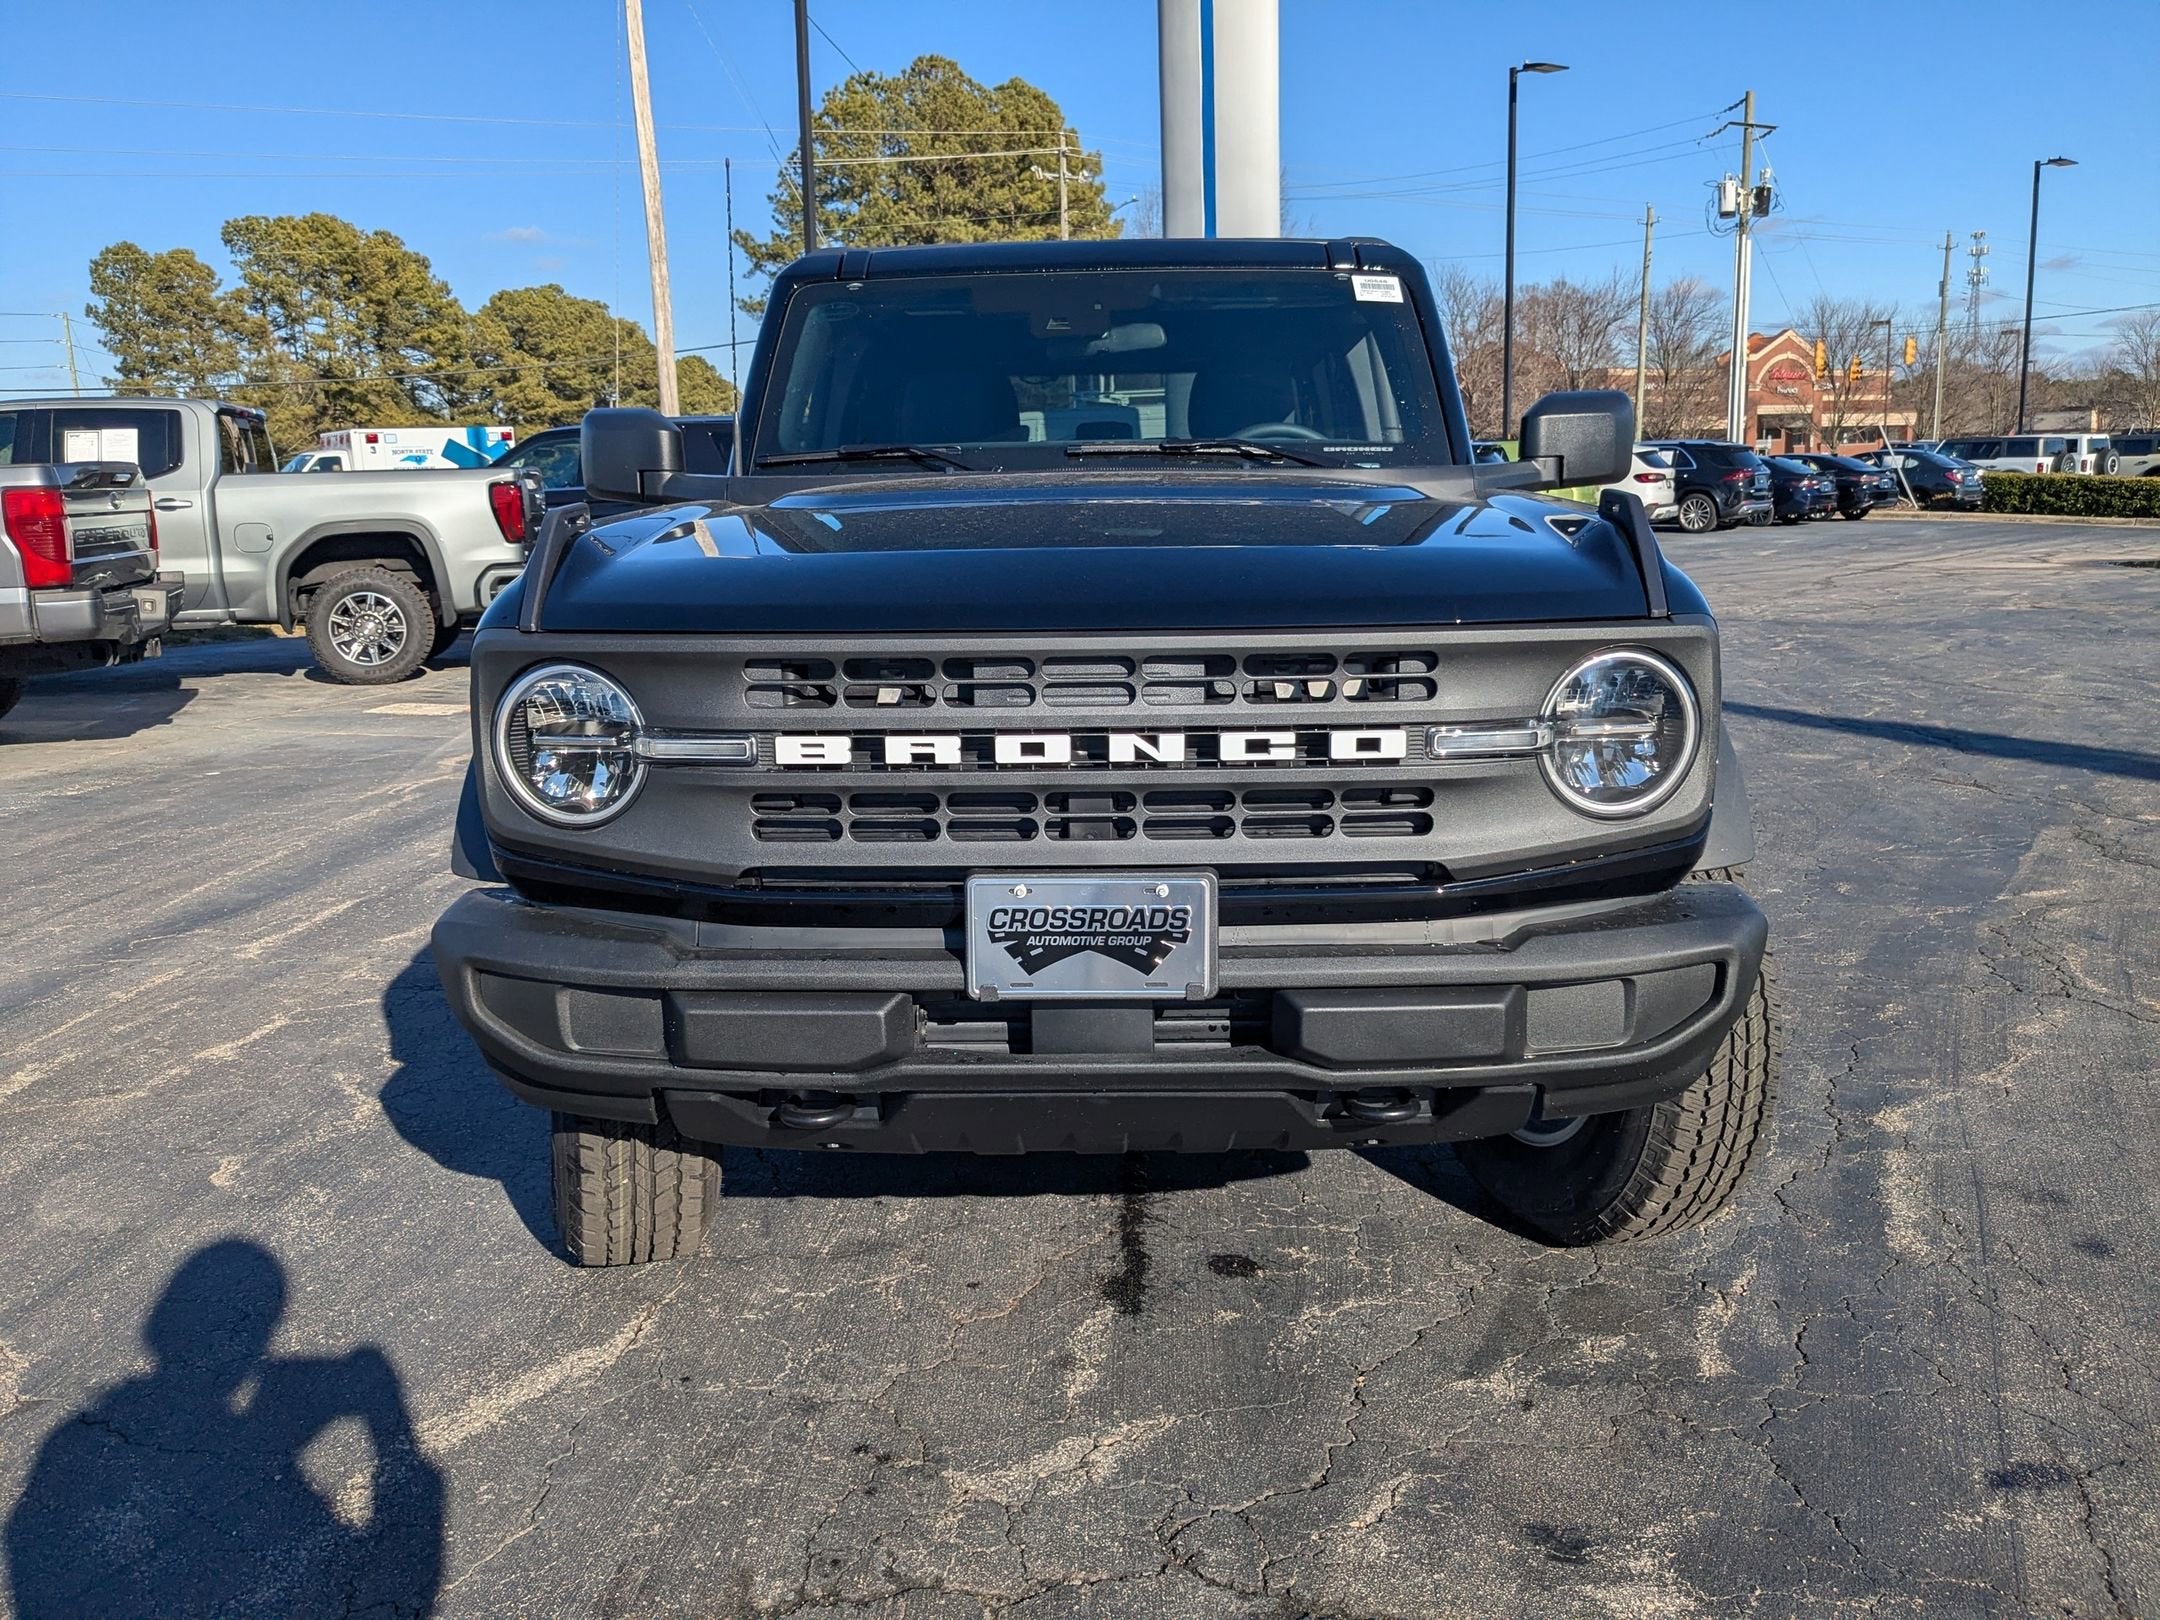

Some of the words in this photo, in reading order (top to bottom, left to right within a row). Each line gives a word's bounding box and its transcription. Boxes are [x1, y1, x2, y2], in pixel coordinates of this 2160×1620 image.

[75, 529, 120, 543] SUPER
[775, 730, 1407, 765] BRONCO
[988, 905, 1191, 932] CROSSROADS
[1026, 935, 1105, 947] AUTOMOTIVE
[1108, 935, 1152, 947] GROUP
